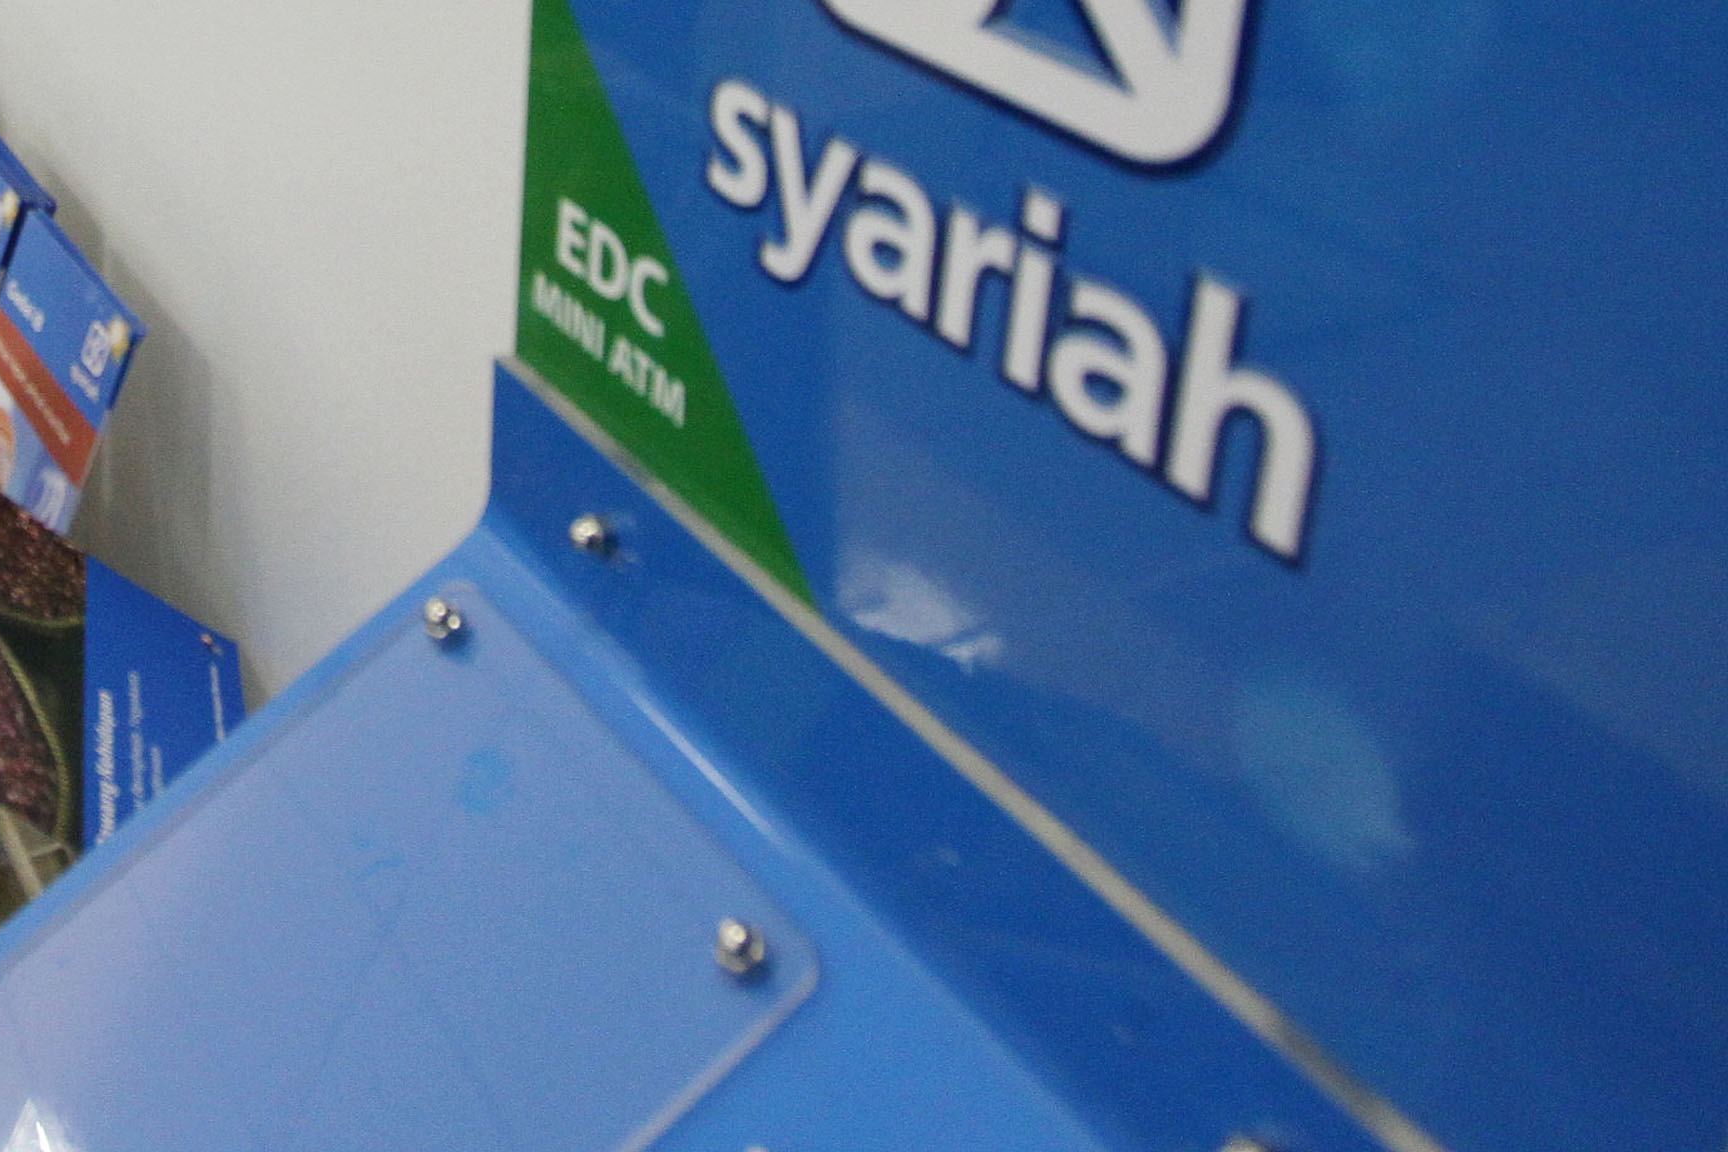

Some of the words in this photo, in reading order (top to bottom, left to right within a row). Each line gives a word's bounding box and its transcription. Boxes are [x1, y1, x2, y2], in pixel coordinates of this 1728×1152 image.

[557, 197, 669, 339] EDC
[708, 79, 1315, 559] syariah
[531, 270, 606, 363] MINI
[608, 335, 687, 429] ATM
